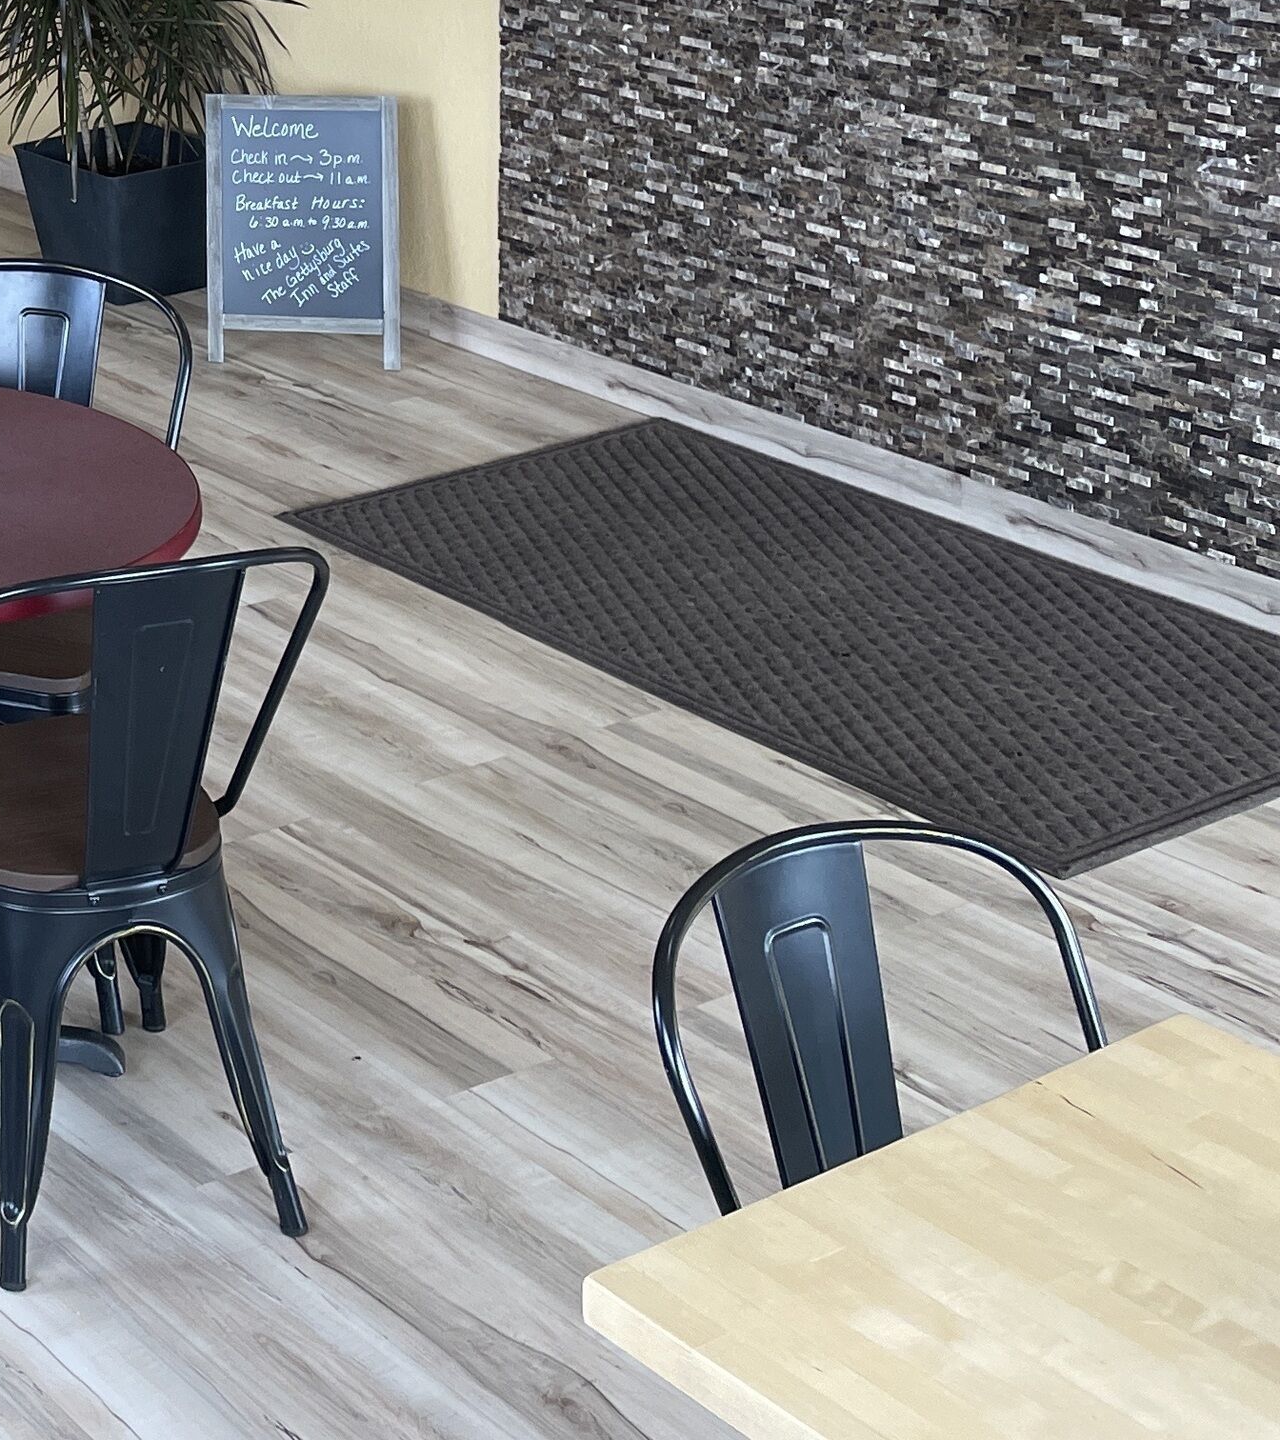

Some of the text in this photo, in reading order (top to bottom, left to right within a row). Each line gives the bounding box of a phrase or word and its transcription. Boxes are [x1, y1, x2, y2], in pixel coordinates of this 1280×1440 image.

[231, 114, 319, 140] Welcome
[230, 148, 269, 165] Check
[274, 150, 288, 166] in
[232, 168, 275, 185] Check
[278, 170, 302, 184] out
[235, 193, 366, 212] Breakfast Hours:
[307, 218, 318, 226] to
[233, 240, 282, 264] Have a
[241, 245, 300, 281] nice day
[261, 238, 346, 305] The Gettysburg
[289, 240, 371, 308] Inn and Suites
[327, 267, 360, 298] Staff
